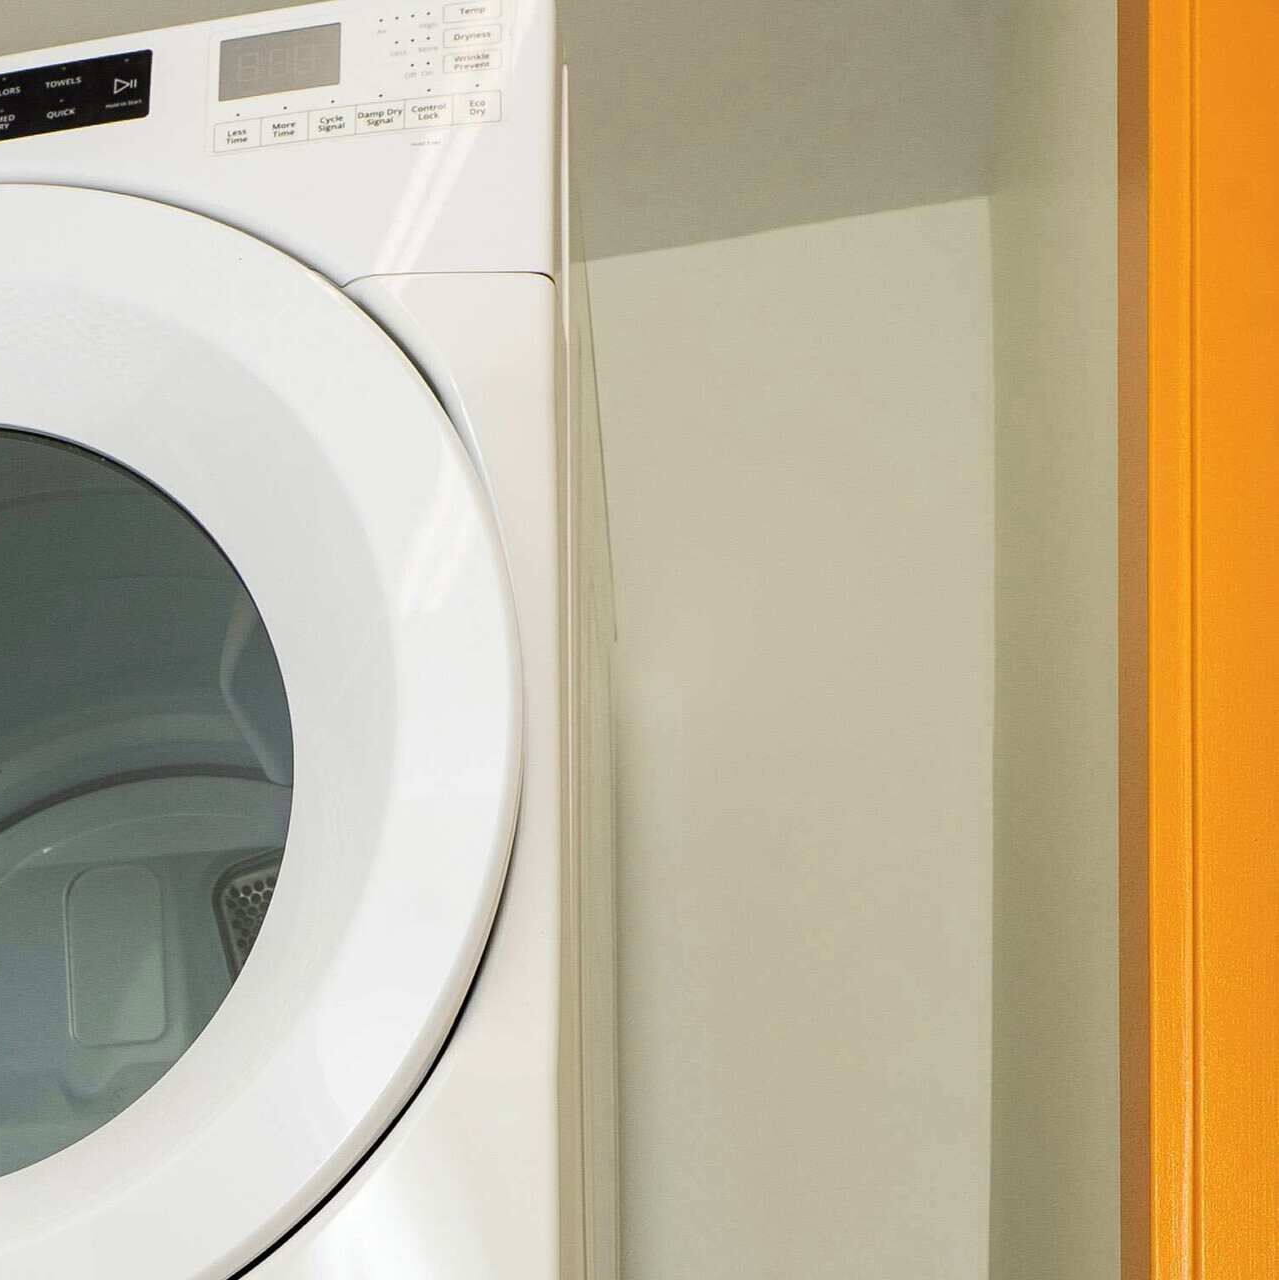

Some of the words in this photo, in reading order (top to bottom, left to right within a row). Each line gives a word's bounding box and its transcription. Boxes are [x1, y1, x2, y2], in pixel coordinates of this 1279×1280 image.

[453, 32, 491, 41] Dryness
[45, 76, 82, 89] TOWELS
[411, 103, 446, 113] Control
[469, 107, 486, 116] Dry
[46, 107, 76, 119] QUICK
[357, 110, 384, 120] Damp
[386, 108, 403, 116] Dry
[418, 112, 438, 121] Lock
[320, 115, 343, 125] Cycle
[367, 117, 393, 127] Signal
[272, 122, 296, 130] More
[318, 122, 345, 132] Signal
[227, 129, 247, 137] Less
[273, 129, 295, 138] Time
[226, 136, 248, 145] Time
